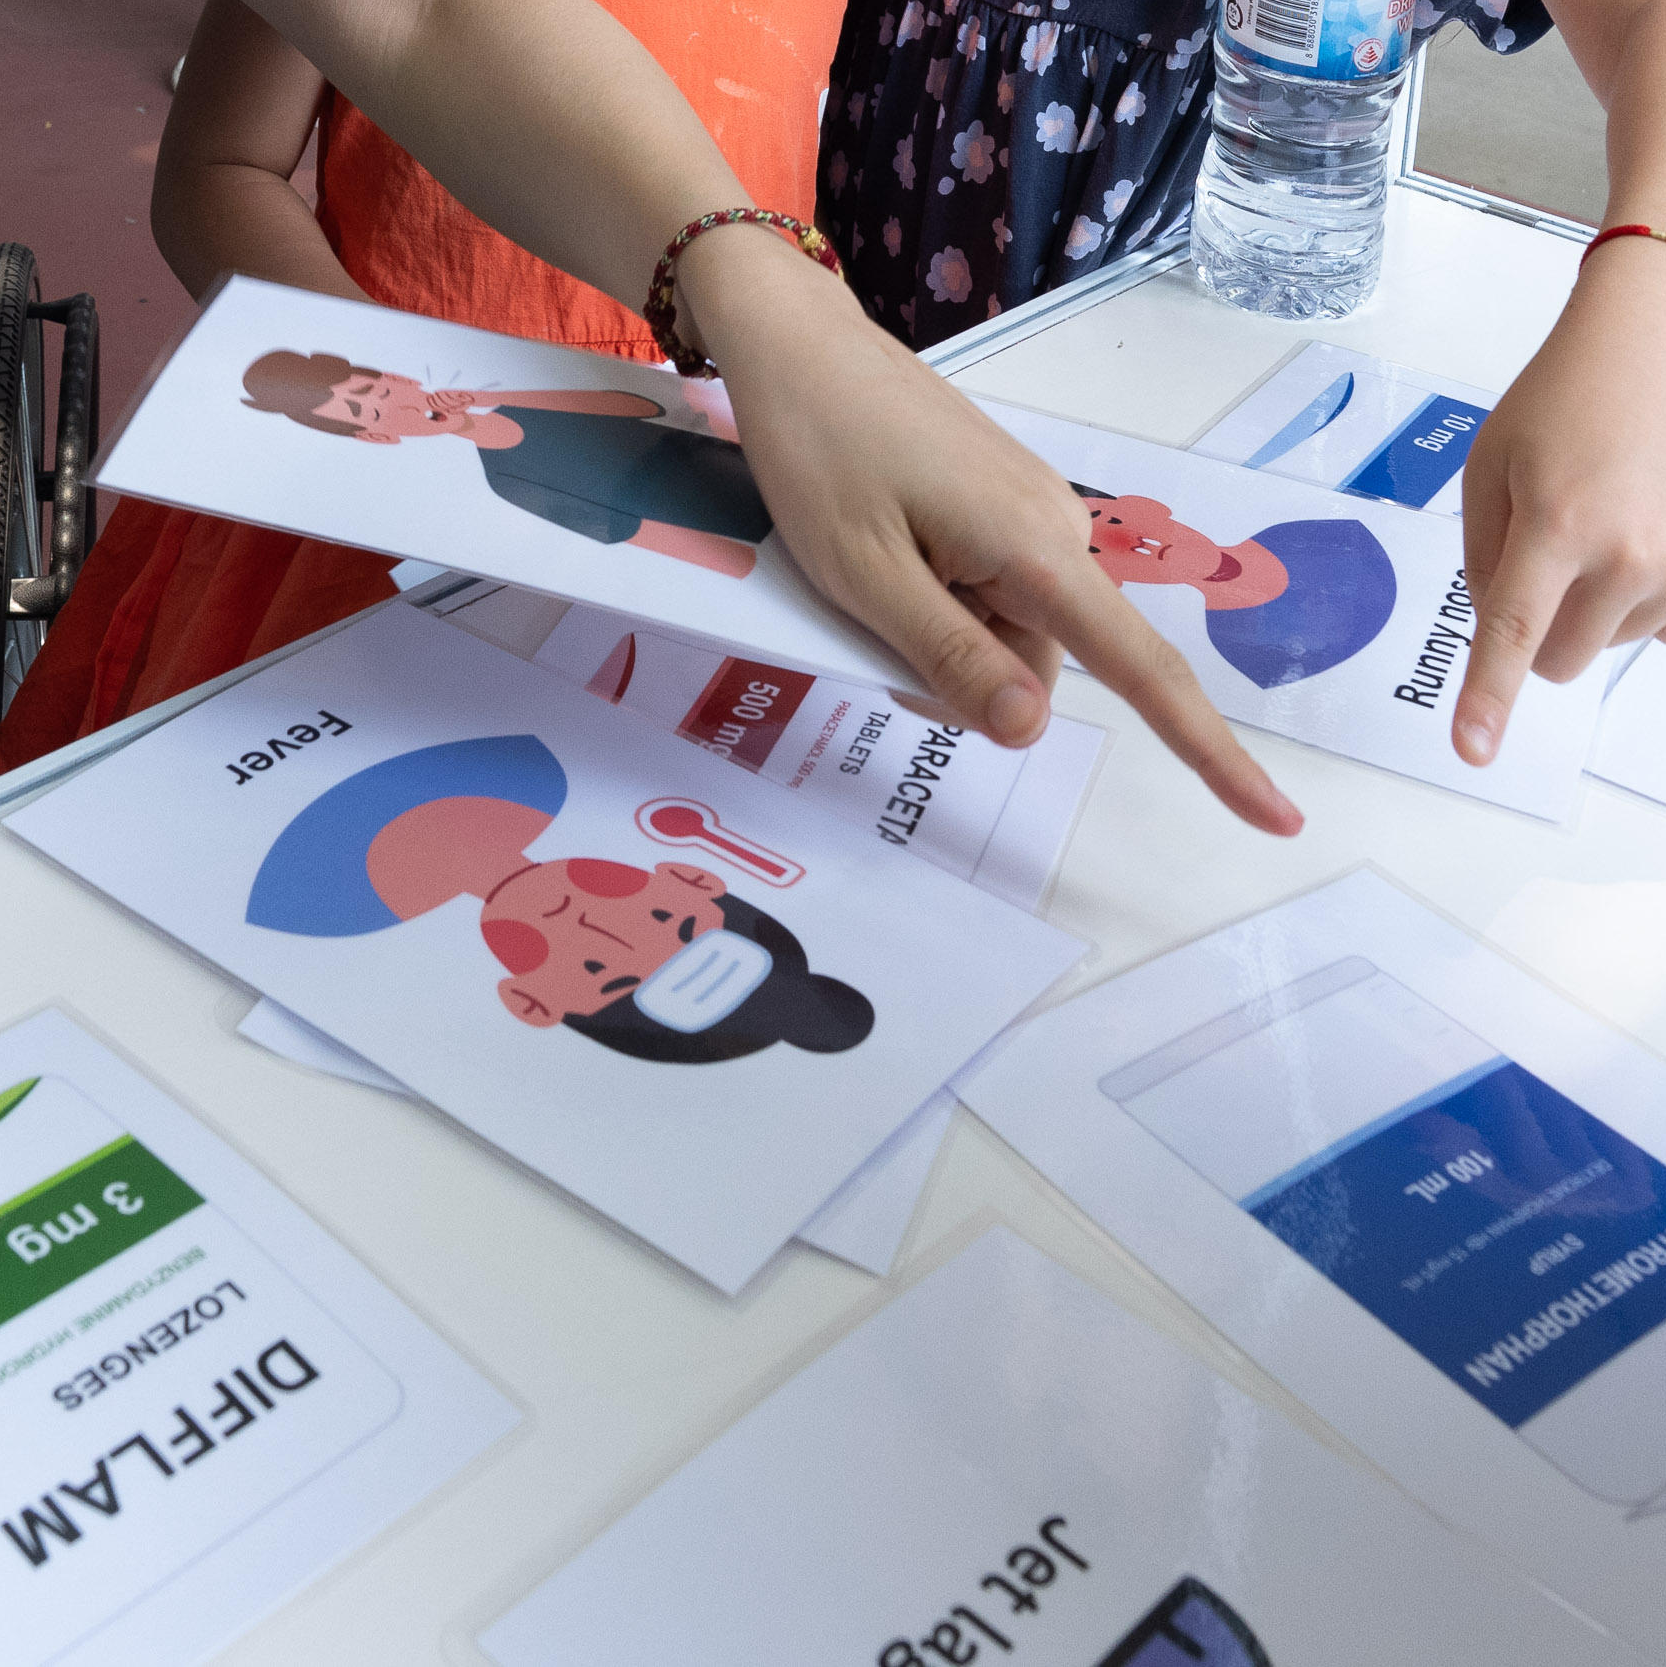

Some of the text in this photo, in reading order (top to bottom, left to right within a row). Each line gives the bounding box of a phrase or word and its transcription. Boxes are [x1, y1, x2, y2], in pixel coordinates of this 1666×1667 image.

[1307, 20, 1317, 49] 888030
[1413, 413, 1477, 453] 10 mg
[1393, 623, 1472, 709] Runny
[226, 710, 353, 785] Fever
[699, 681, 781, 759] 500 mg
[806, 700, 851, 759] PARACETAMOL
[839, 710, 892, 775] TABLETS
[797, 759, 817, 777] 500
[876, 724, 964, 846] PARACETA
[1403, 1149, 1494, 1203] 100 mL
[6, 1181, 145, 1265] 3 mg
[1529, 1232, 1584, 1276] SYRUP
[73, 1244, 207, 1338] BENZYDAMINE
[52, 1278, 247, 1412] LOZENGES
[0, 1336, 322, 1567] DIFFLAM
[981, 1515, 1091, 1615] Jet
